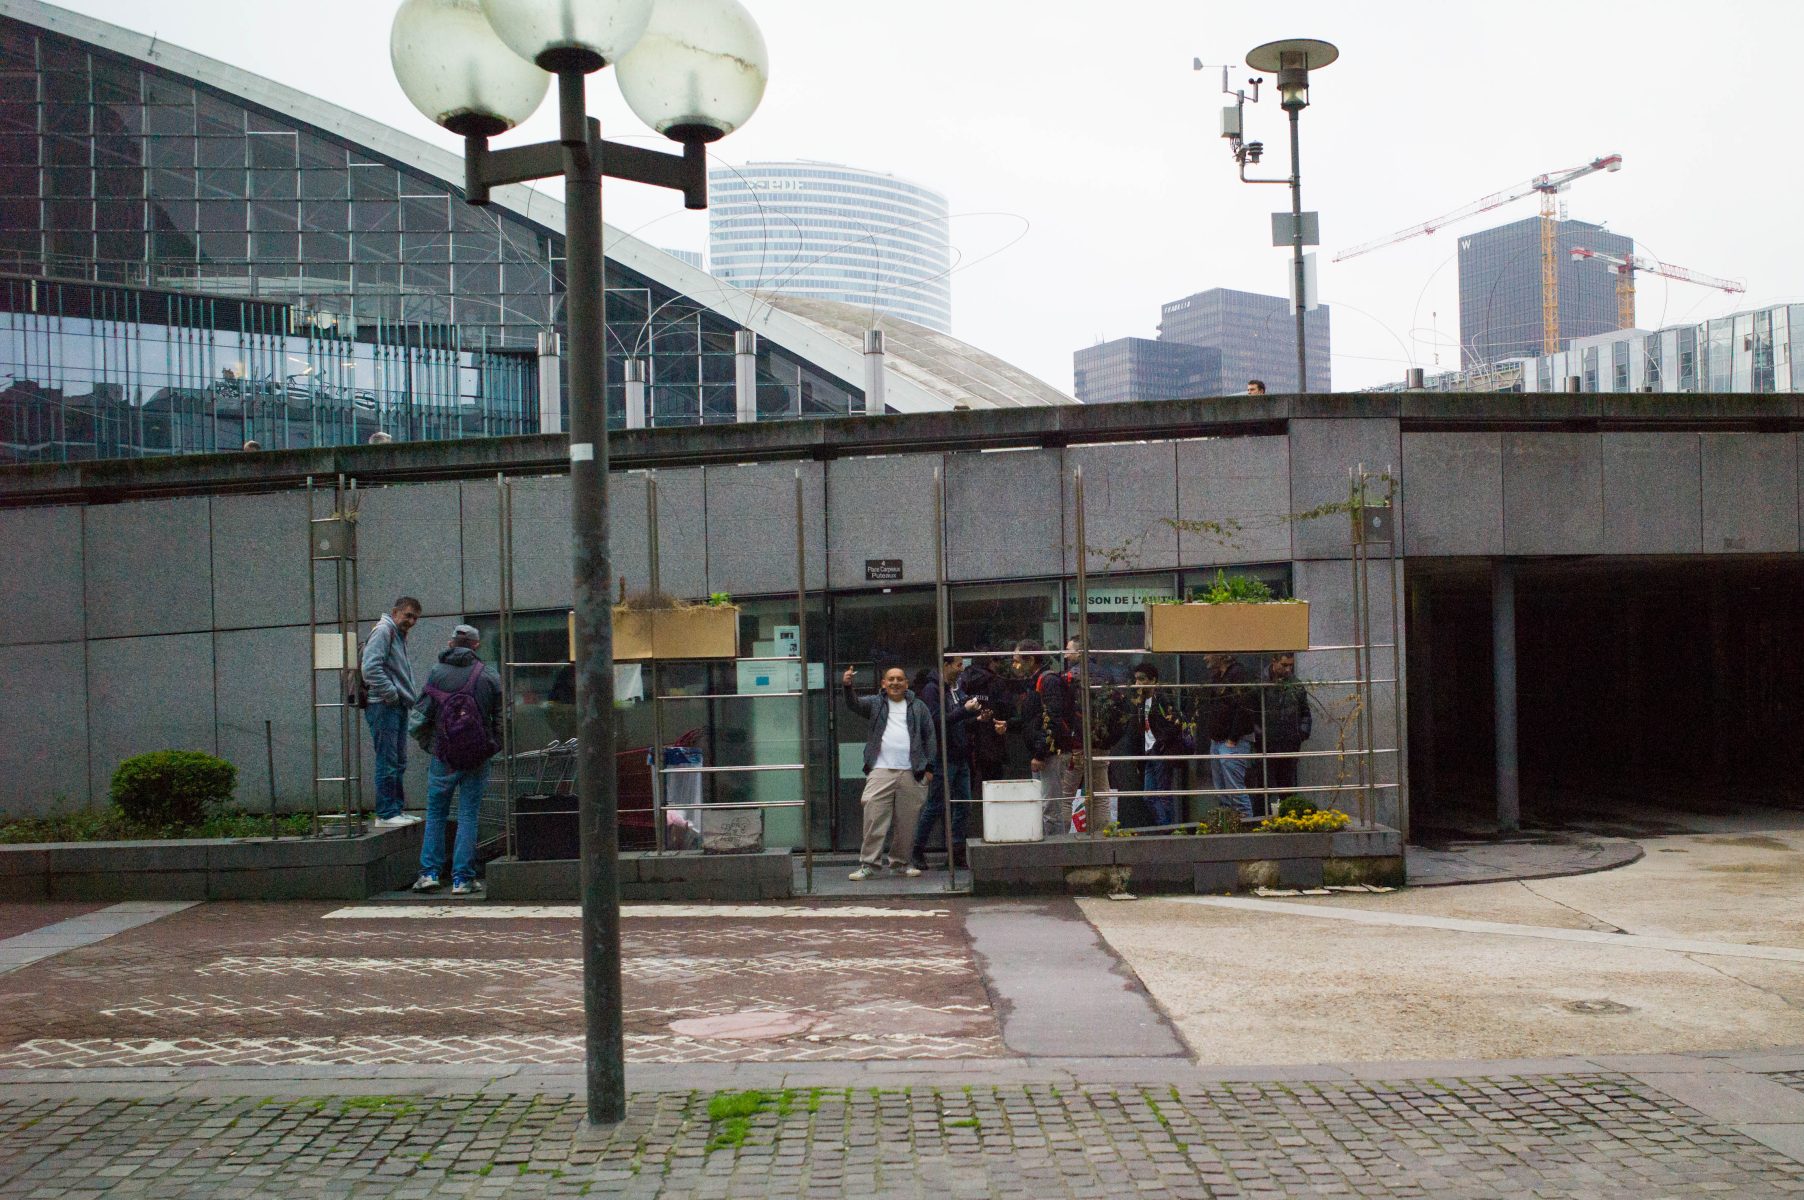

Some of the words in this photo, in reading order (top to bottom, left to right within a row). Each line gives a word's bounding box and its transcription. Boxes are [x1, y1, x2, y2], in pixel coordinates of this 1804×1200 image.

[1461, 240, 1471, 250] W
[1069, 596, 1111, 605] MSON
[1114, 596, 1129, 605] DE
